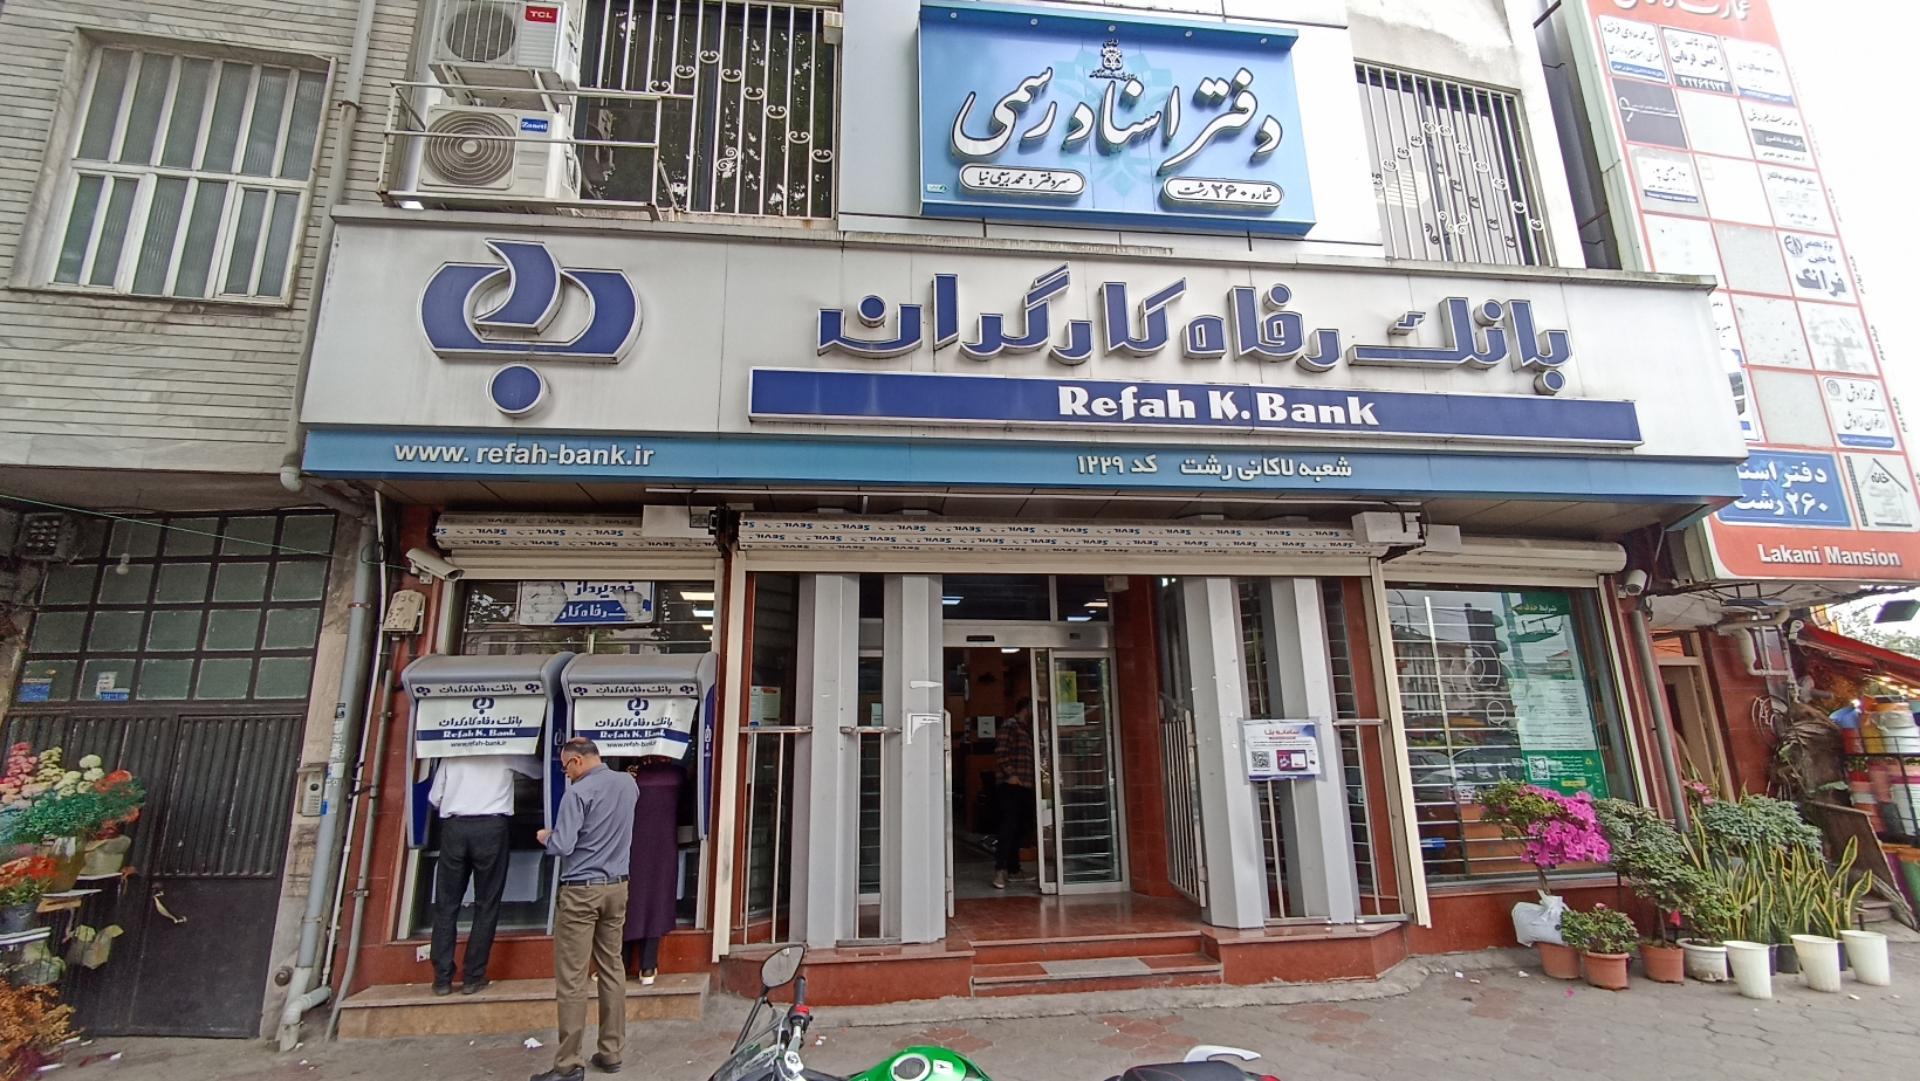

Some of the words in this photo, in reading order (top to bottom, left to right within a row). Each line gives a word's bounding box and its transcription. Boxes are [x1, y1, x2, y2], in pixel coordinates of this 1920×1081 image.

[530, 10, 553, 19] TCL
[951, 66, 1057, 158] رسمی
[1061, 79, 1181, 152] اسناد
[1157, 67, 1283, 175] دفتر
[1011, 173, 1027, 184] محمد
[1177, 182, 1209, 197] رشت
[1211, 184, 1248, 199] ۲۶۰
[1250, 187, 1273, 200] شماره
[817, 261, 1188, 367] کارگران
[1180, 282, 1342, 373] رفاه
[1348, 296, 1573, 396] بانک
[1057, 385, 1196, 421] Refah
[1077, 455, 1125, 474] ۱۲۲۹
[1130, 454, 1158, 473] کد
[1180, 455, 1232, 481] رشت
[1236, 456, 1295, 481] لاکانی
[1298, 456, 1352, 483] شعبه
[1781, 461, 1828, 488] دفتر
[1734, 489, 1785, 516] رشت
[1785, 492, 1829, 515] ۲۶۰
[896, 524, 926, 532] SEVIL
[1757, 544, 1823, 564] Lakani
[1824, 546, 1902, 567] Mansion
[581, 604, 607, 618] رفاه
[439, 717, 476, 727] کارگران
[476, 717, 495, 726] رفاه
[496, 716, 523, 727] بانک
[595, 717, 633, 728] کارگران
[633, 717, 650, 727] رفاه
[651, 716, 673, 727] بانک
[443, 729, 474, 738] Refah
[489, 729, 516, 737] Bank
[600, 729, 630, 738] Refah
[644, 728, 666, 738] Bank
